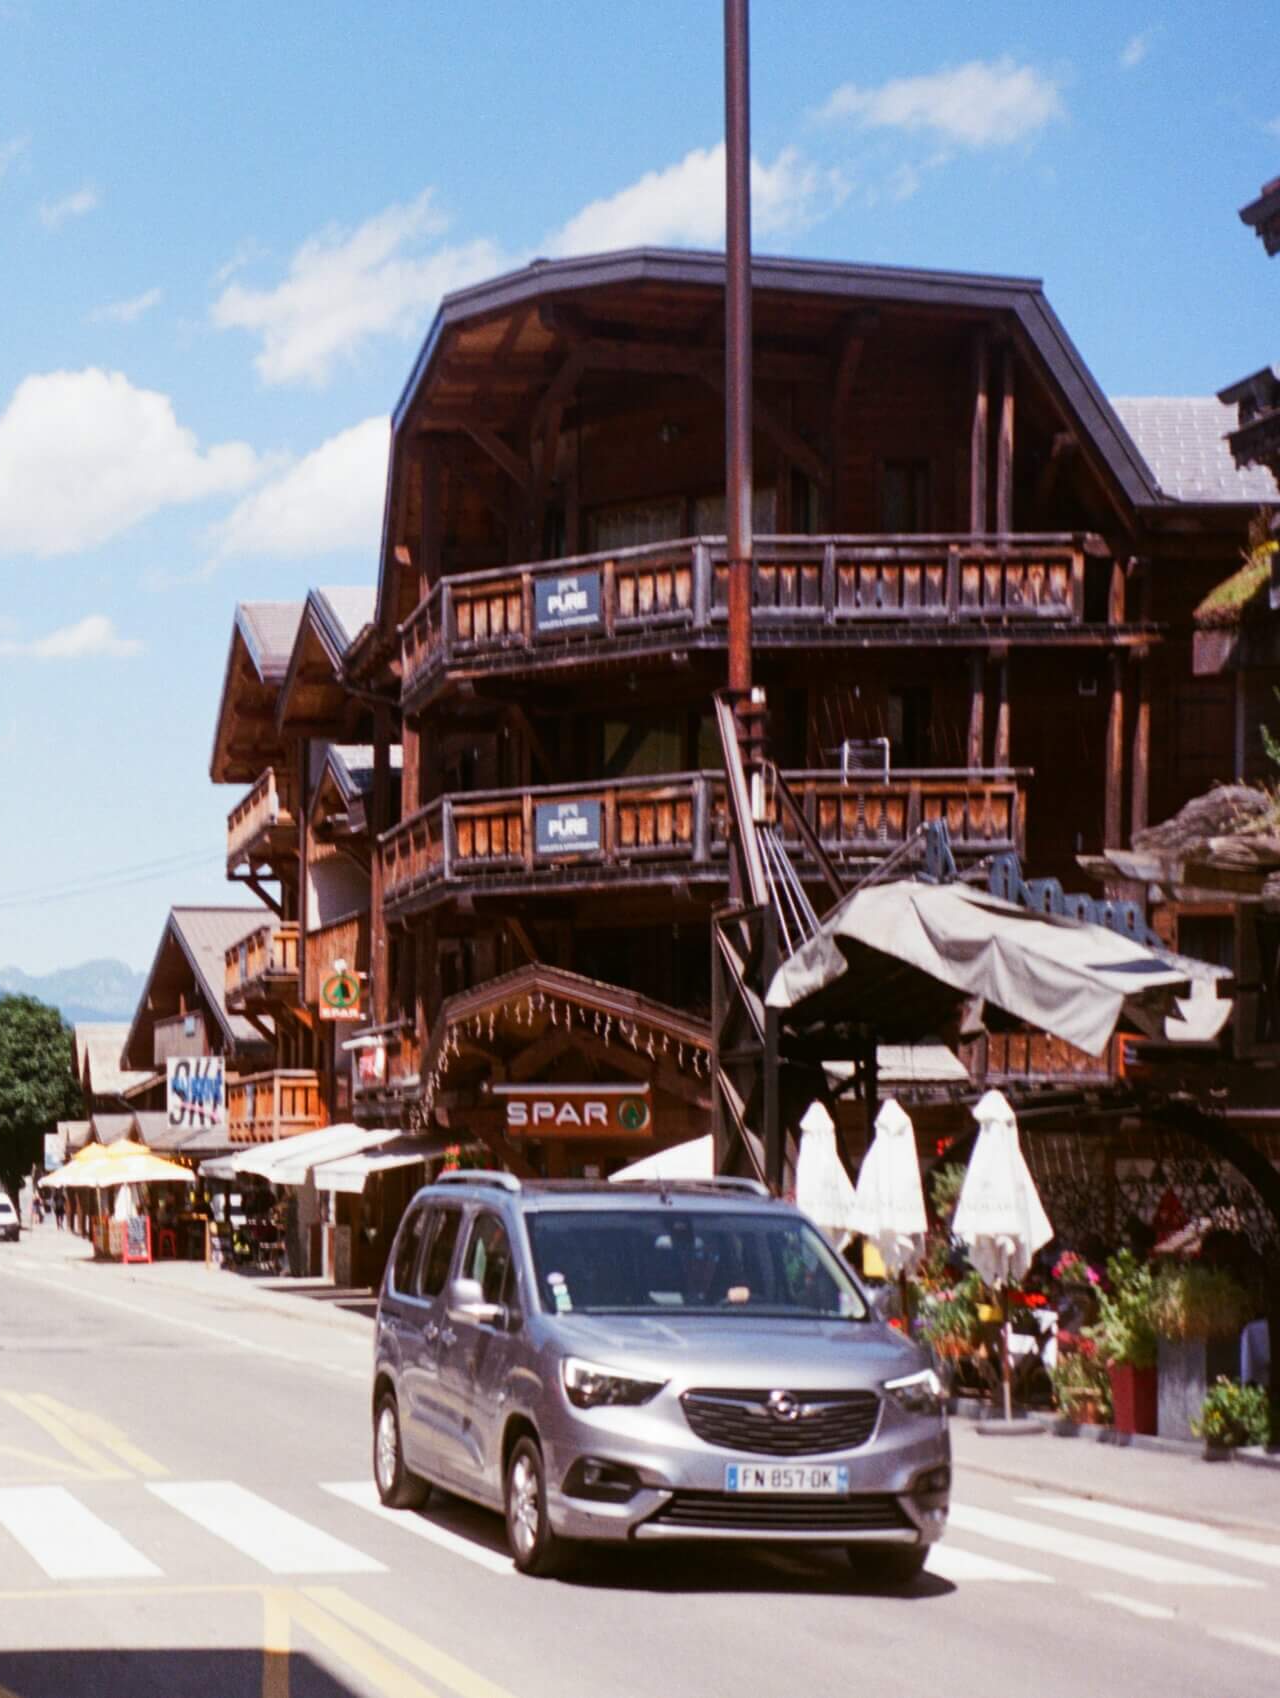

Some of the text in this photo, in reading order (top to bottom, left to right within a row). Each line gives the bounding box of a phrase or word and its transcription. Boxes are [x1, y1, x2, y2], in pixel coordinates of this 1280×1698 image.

[548, 590, 588, 614] PURE
[548, 817, 588, 838] PURE
[322, 1008, 359, 1018] SPAR
[507, 1102, 608, 1126] SPAR
